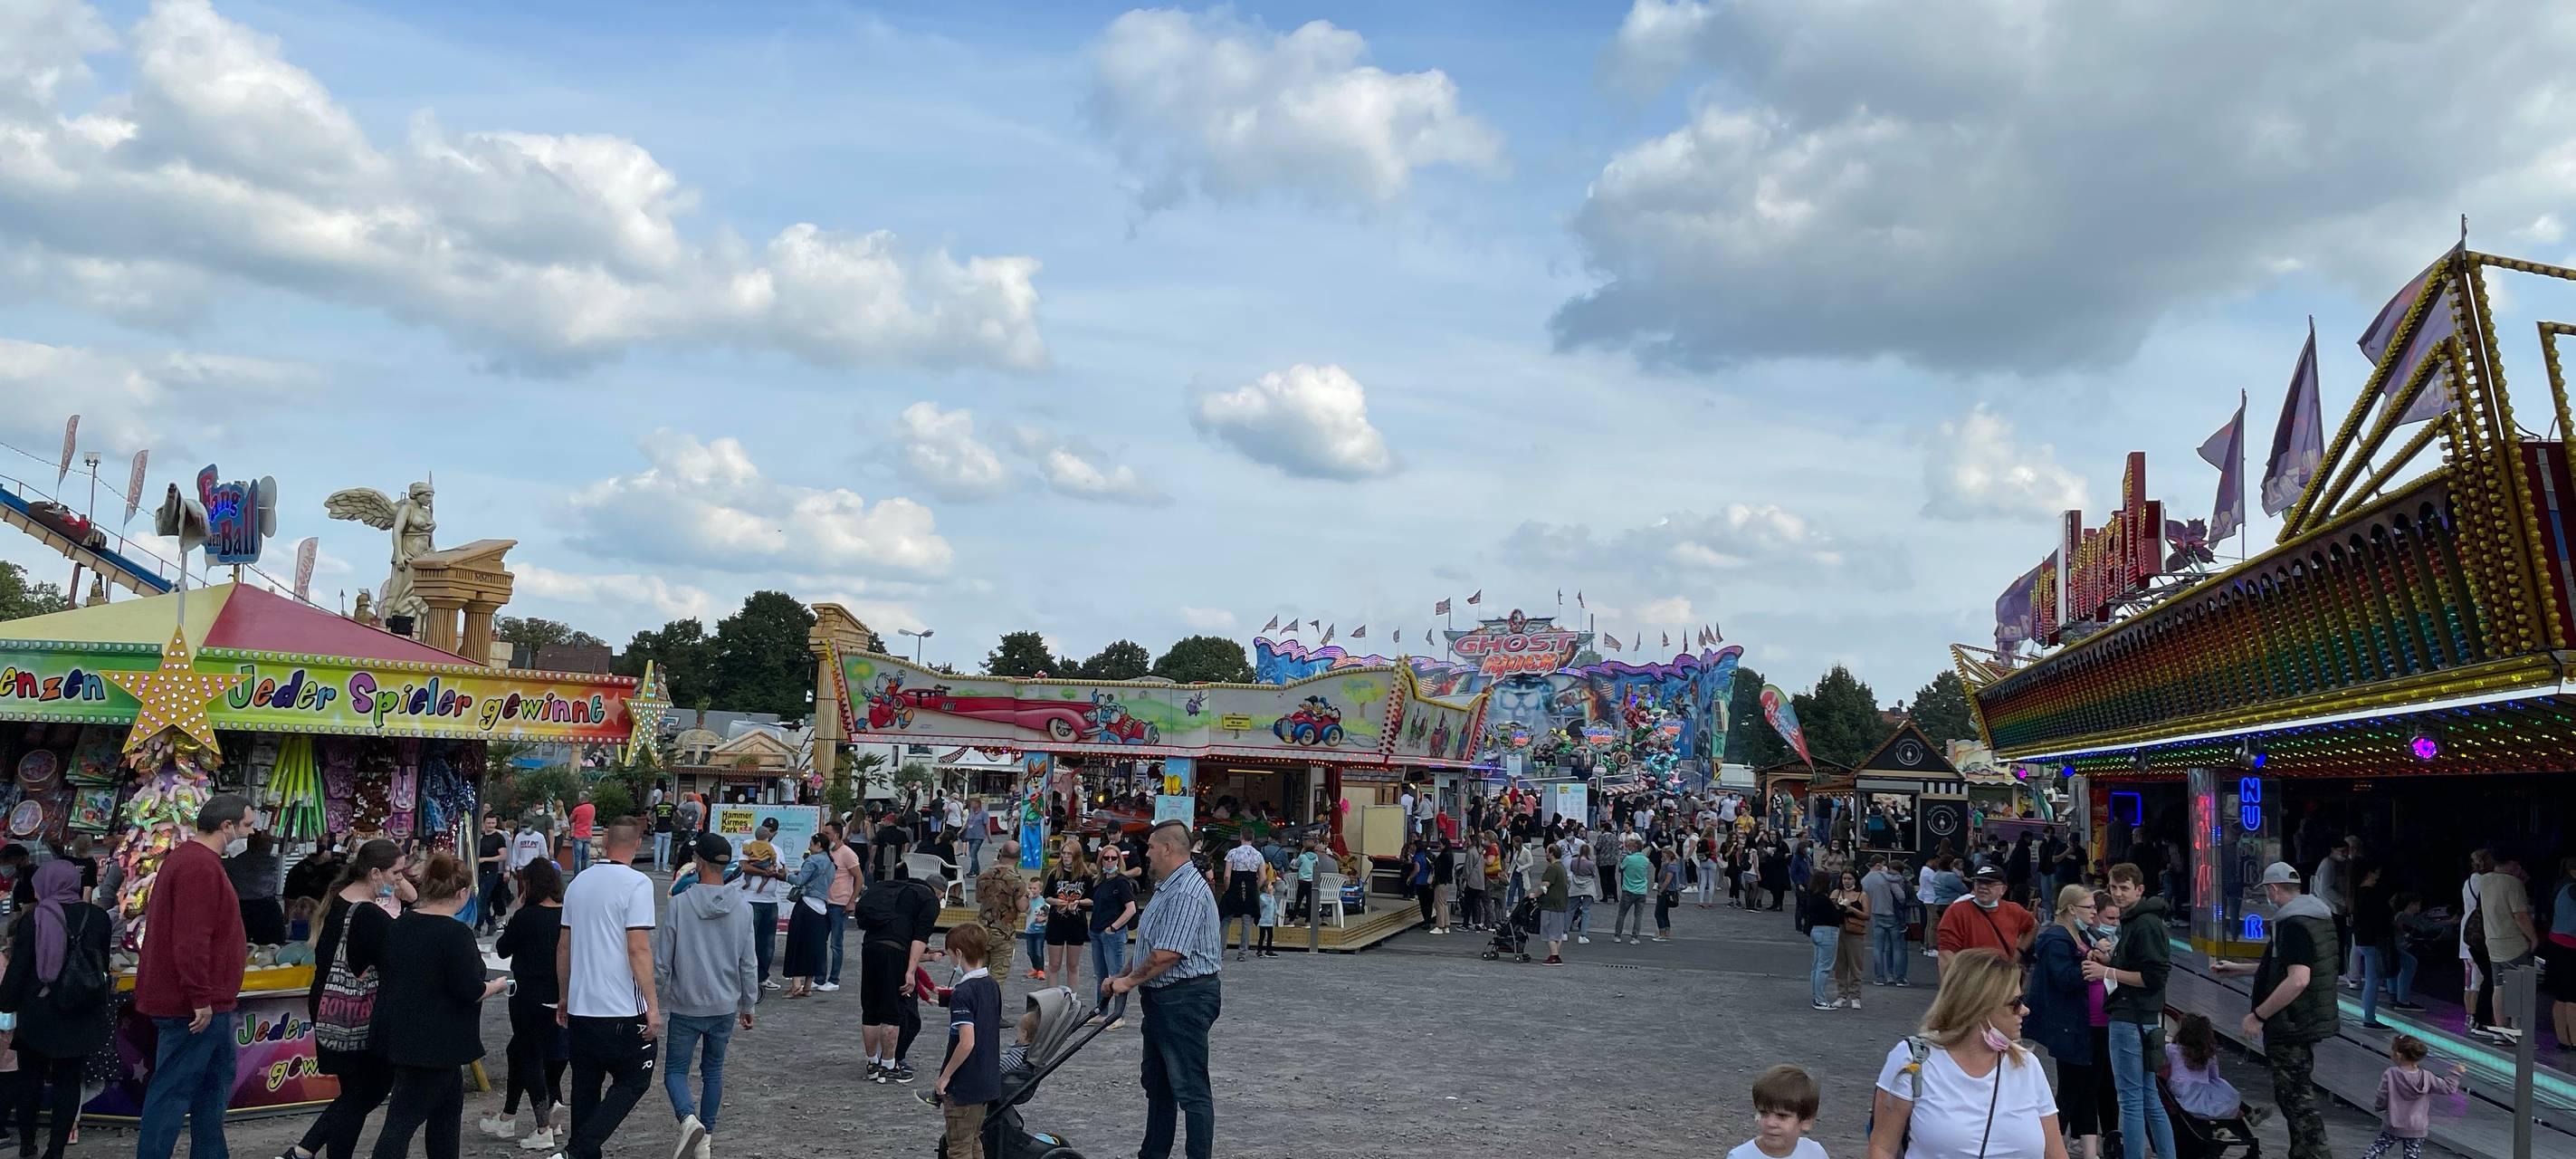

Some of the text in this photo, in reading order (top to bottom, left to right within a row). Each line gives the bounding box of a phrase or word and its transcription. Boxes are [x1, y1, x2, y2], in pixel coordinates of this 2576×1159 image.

[200, 472, 242, 522] Fang
[220, 491, 256, 555] Ball
[1455, 633, 1577, 655] GHOST
[228, 665, 605, 731] Jeder Spieler gewinnt
[722, 811, 753, 819] Hammer
[237, 1011, 312, 1045] Jeder
